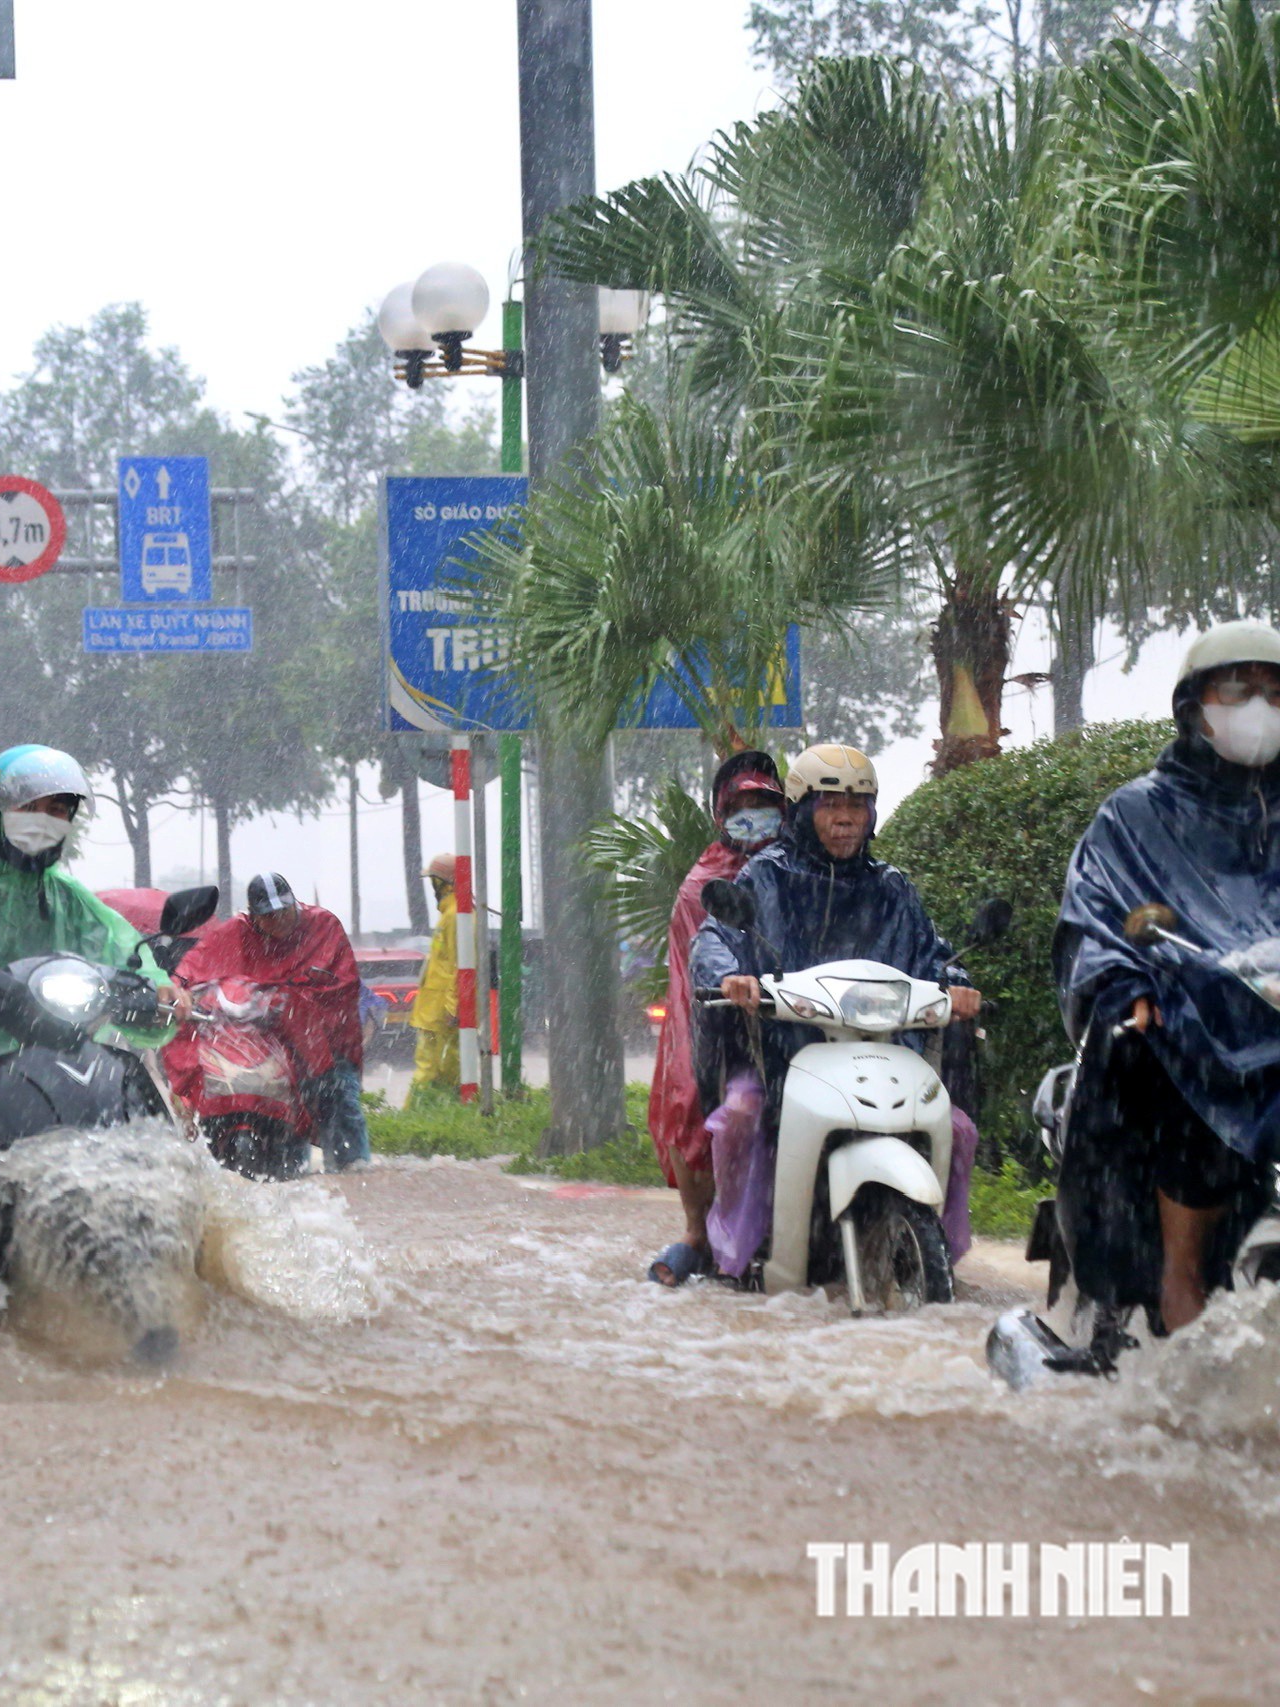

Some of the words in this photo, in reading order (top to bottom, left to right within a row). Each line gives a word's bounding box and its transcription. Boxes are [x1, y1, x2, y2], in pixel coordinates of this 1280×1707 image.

[146, 506, 183, 525] BRT
[440, 503, 482, 521] GIÁO
[126, 613, 147, 629] XE
[90, 633, 116, 646] Bus
